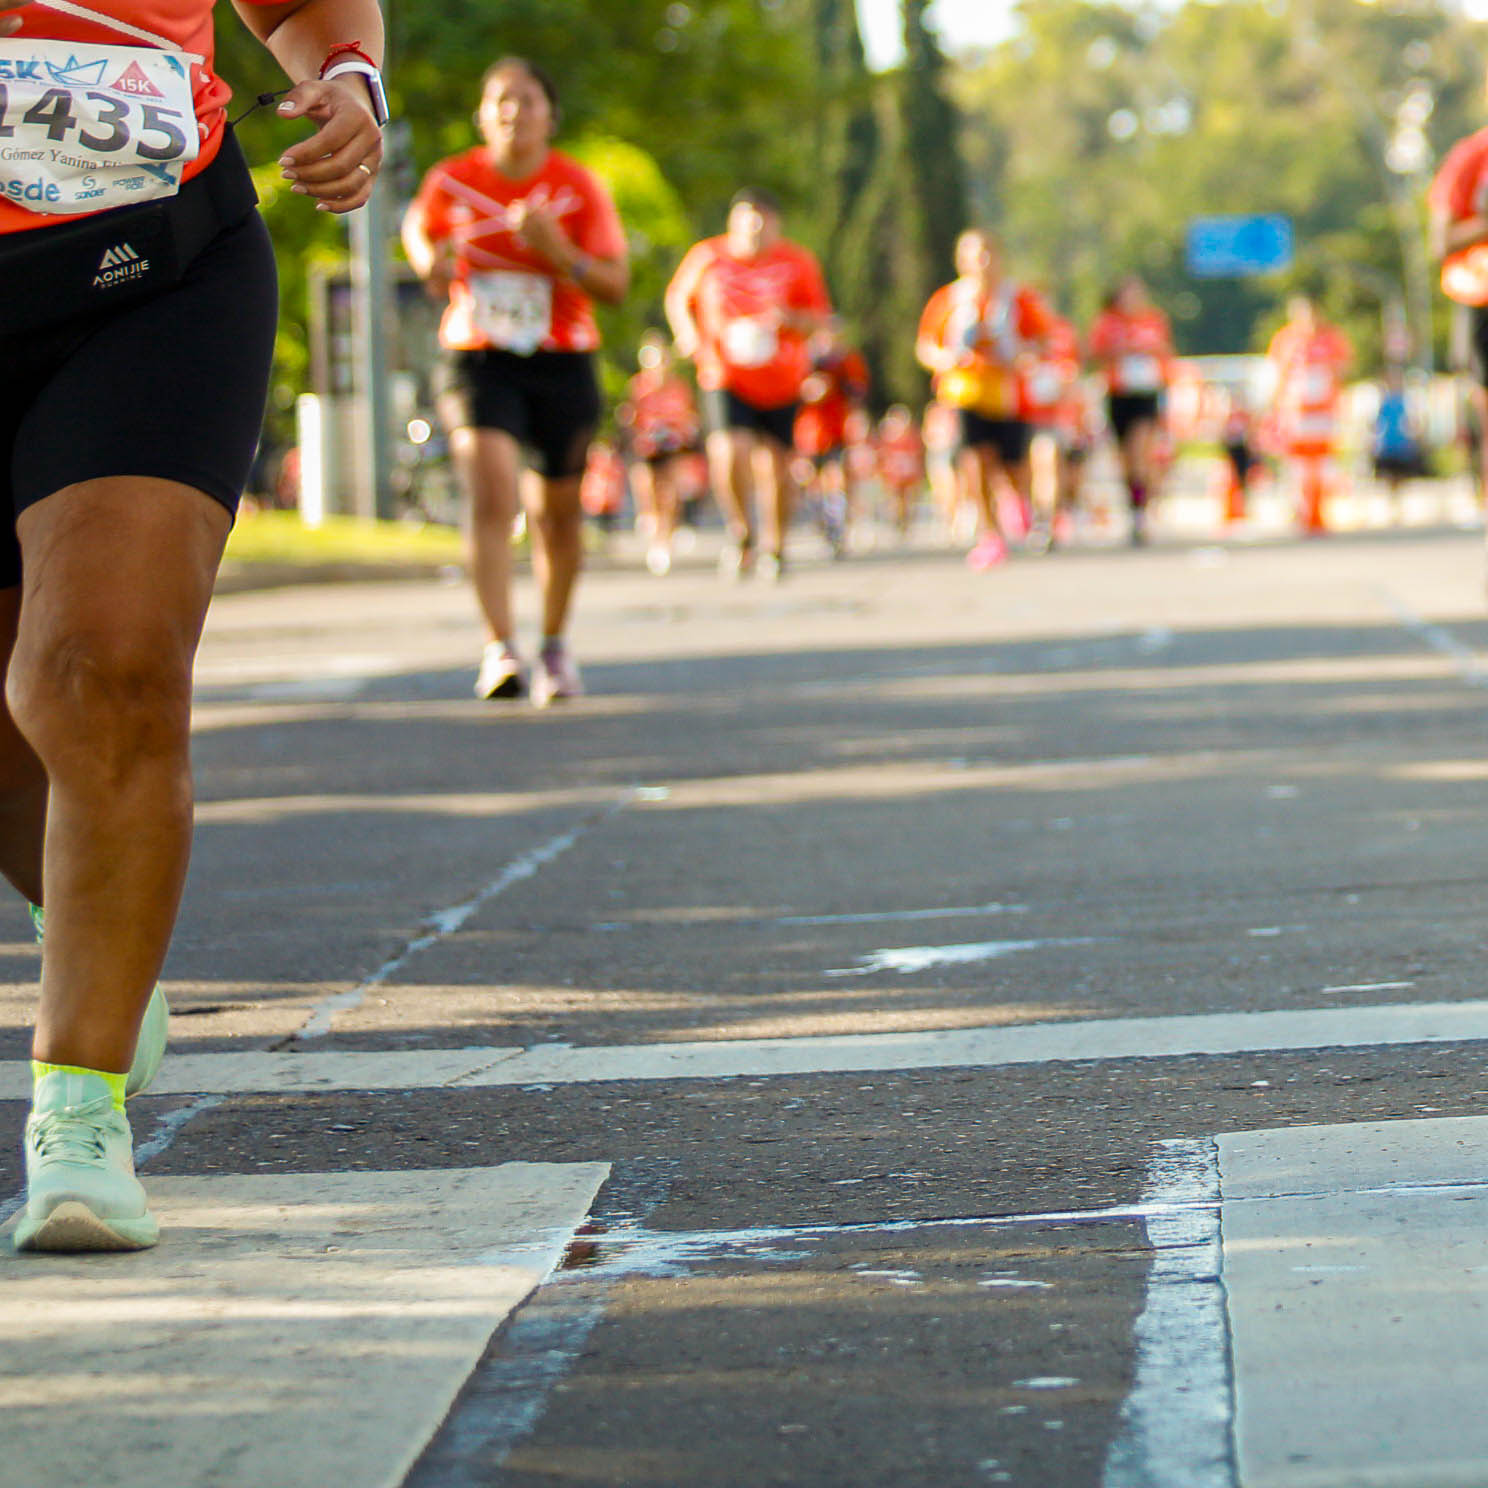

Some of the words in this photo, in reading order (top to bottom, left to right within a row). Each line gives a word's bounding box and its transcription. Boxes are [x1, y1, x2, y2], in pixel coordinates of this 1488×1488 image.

[118, 78, 152, 93] 15K
[1, 146, 46, 162] Gómez
[92, 259, 151, 286] AONIJIE
